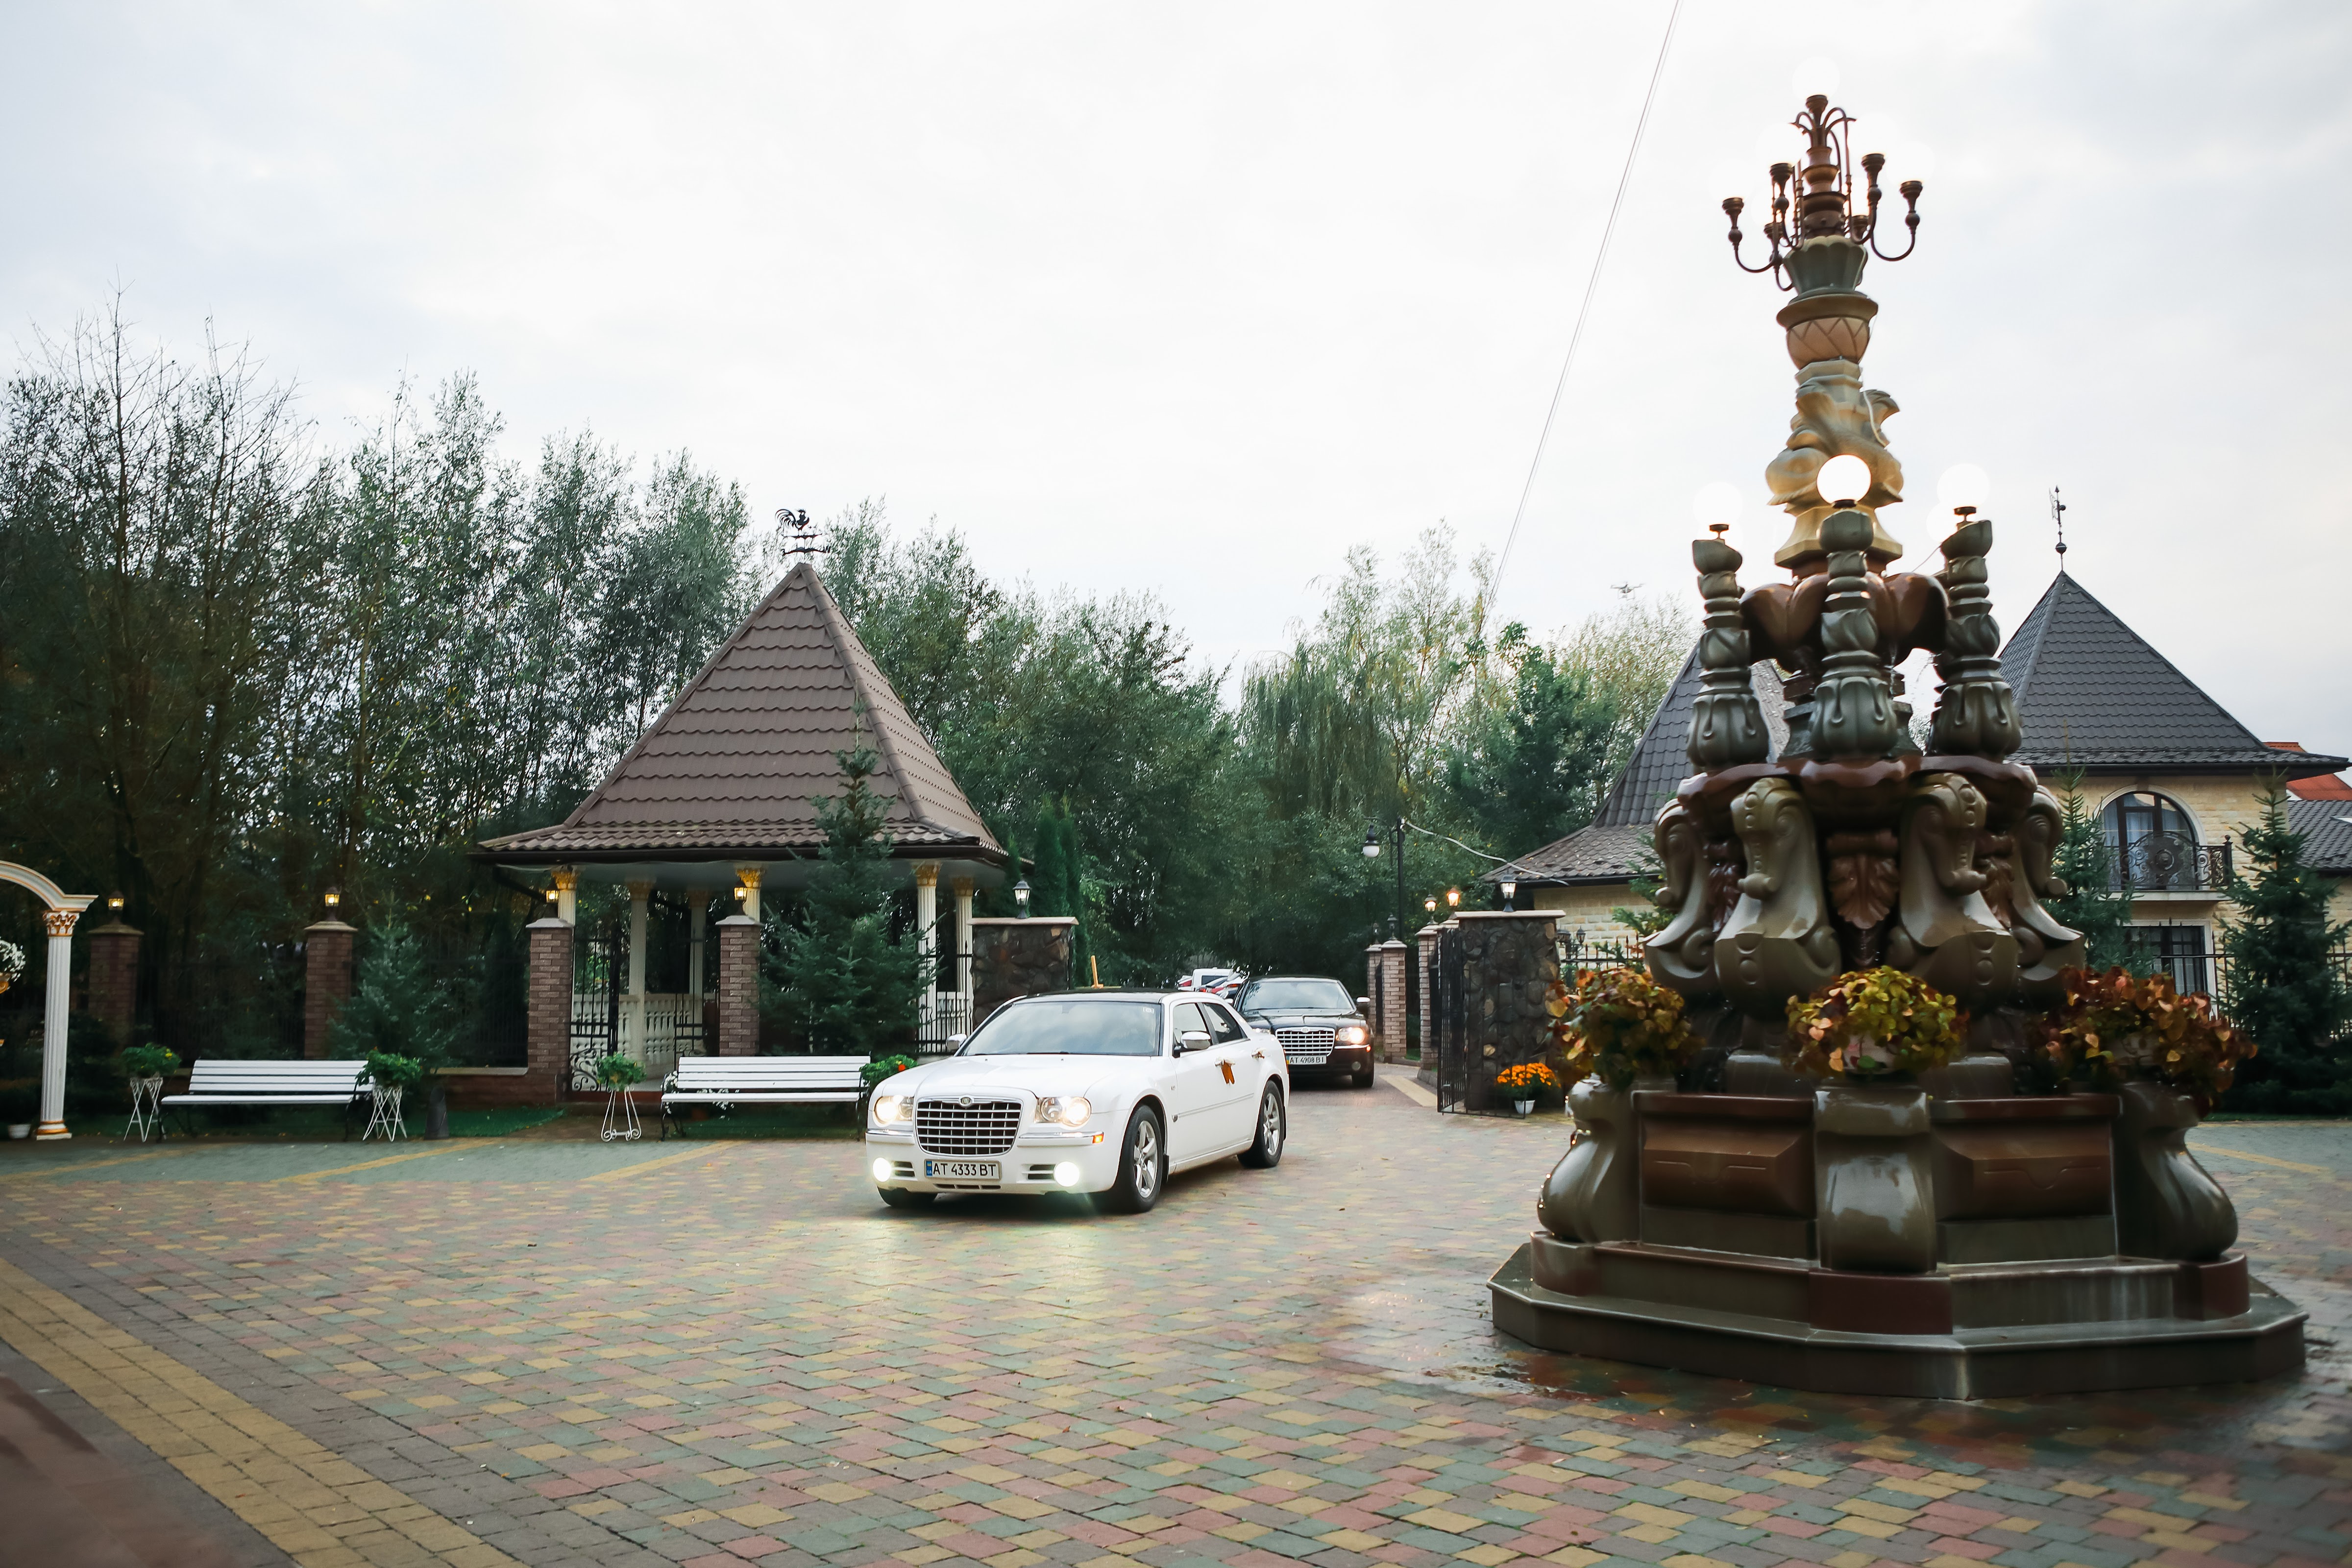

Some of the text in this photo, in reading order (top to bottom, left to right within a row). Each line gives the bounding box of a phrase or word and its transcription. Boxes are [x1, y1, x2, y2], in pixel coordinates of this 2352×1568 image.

[933, 1163, 996, 1176] AT 4333 BT
